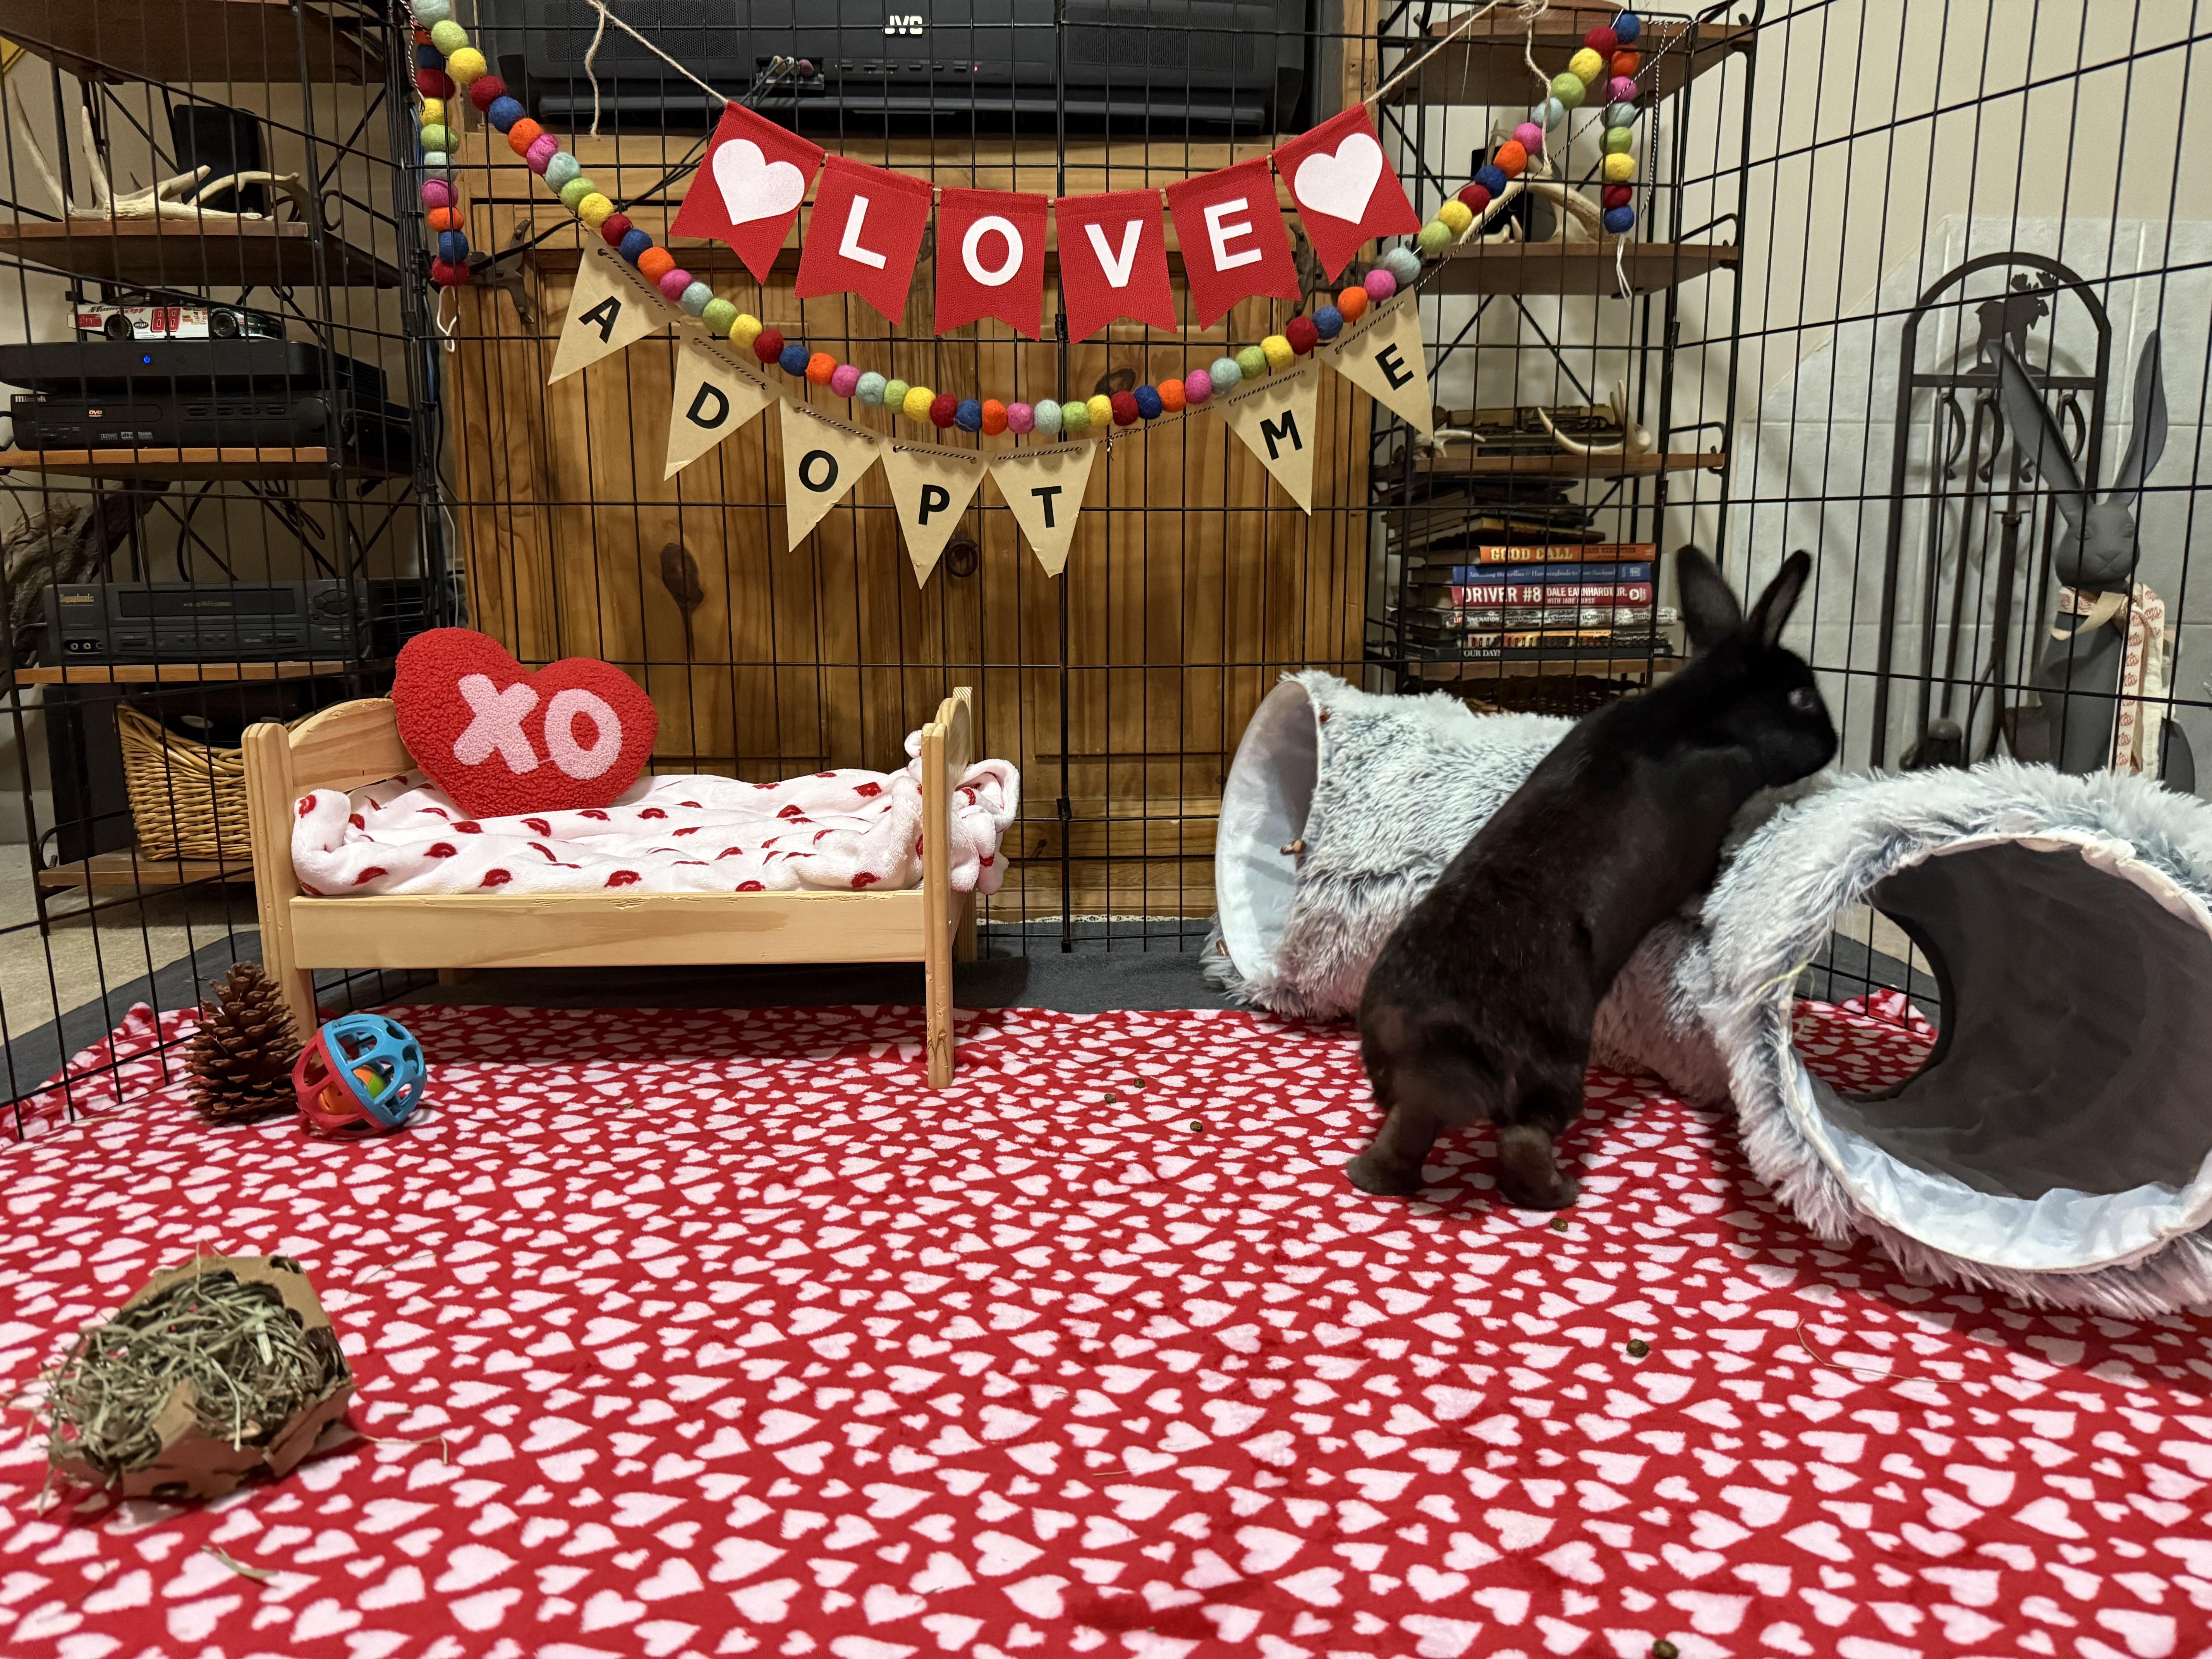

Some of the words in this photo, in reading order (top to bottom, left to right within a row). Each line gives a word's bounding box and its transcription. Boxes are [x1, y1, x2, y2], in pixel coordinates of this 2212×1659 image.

[882, 15, 923, 34] JVC
[839, 194, 1262, 288] LOVE
[151, 306, 181, 332] 88
[579, 295, 1062, 528] ADOPT
[1259, 343, 1415, 460] ME
[1491, 548, 1530, 561] GOOD
[1536, 546, 1573, 560] CALL
[1462, 587, 1517, 603] DRIVER
[1523, 587, 1541, 602] #8
[1546, 587, 1566, 597] DALE
[1568, 586, 1614, 597] EARNHARDT
[1616, 586, 1627, 596] JR.
[453, 673, 623, 780] XO
